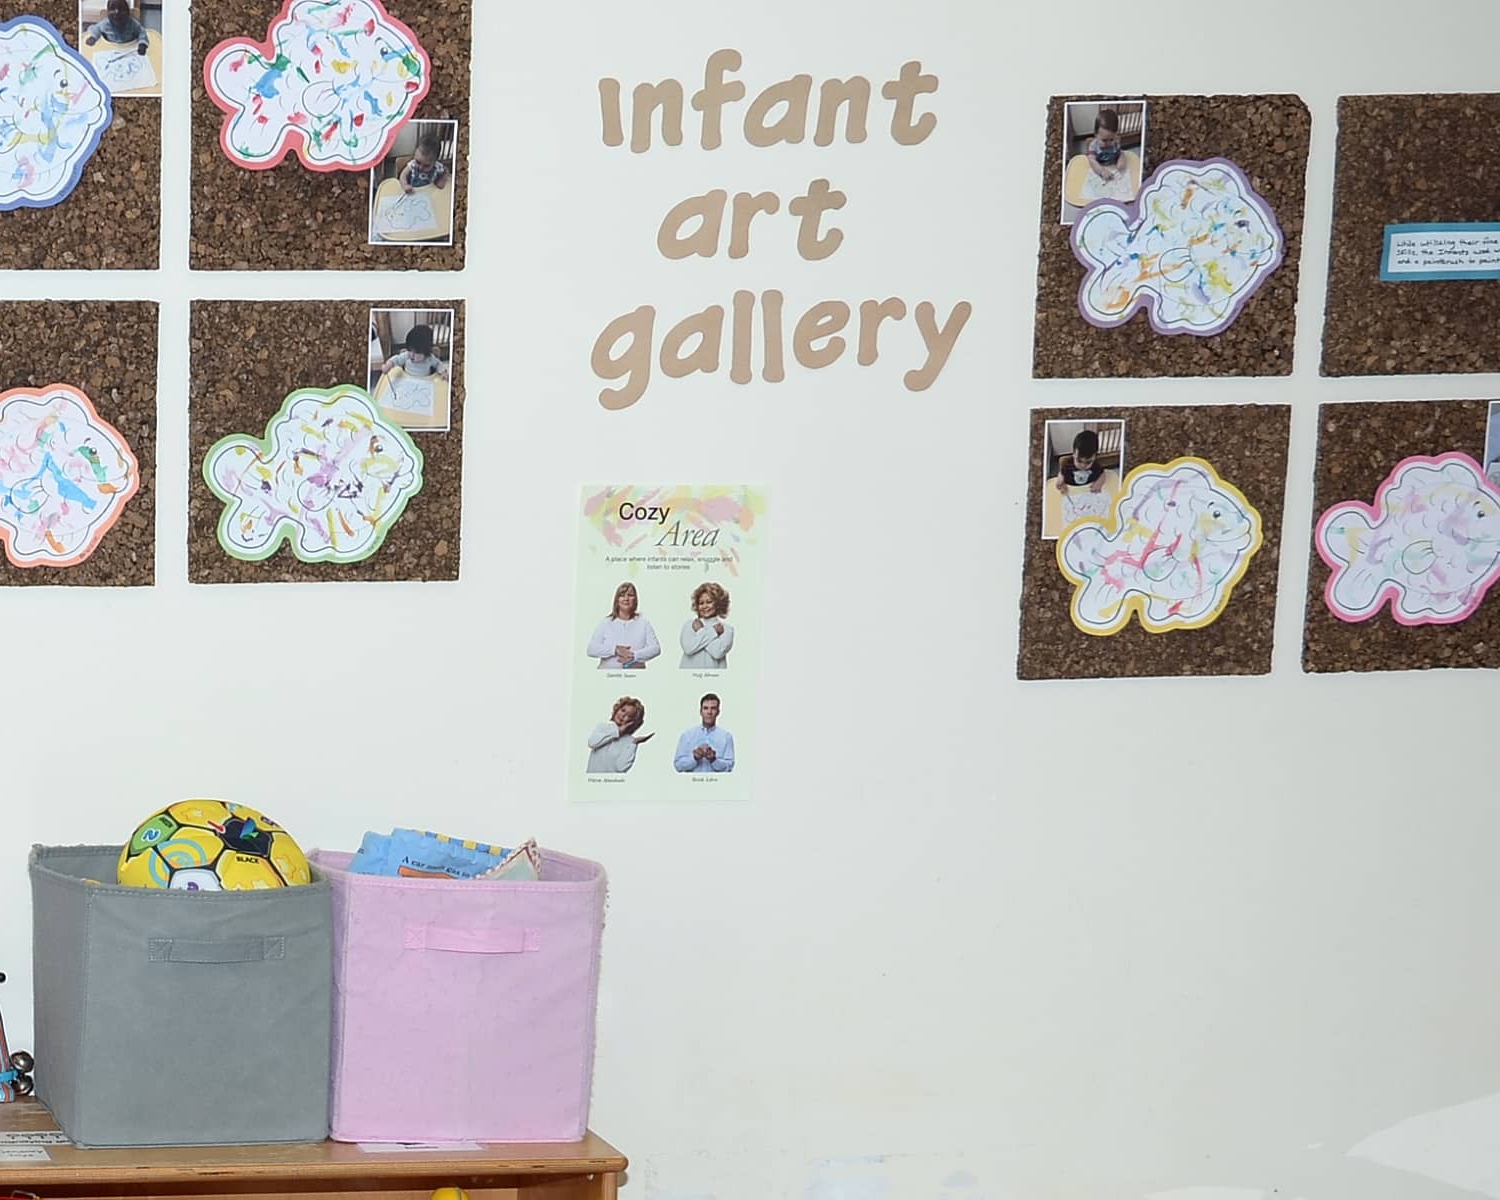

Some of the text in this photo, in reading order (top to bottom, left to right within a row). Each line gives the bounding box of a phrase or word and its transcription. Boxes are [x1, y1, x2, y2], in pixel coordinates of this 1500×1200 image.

[598, 48, 939, 154] Infant
[657, 178, 847, 261] art
[590, 289, 972, 411] gallery
[619, 502, 670, 525] Cozy
[655, 520, 720, 547] Area
[611, 556, 627, 564] place
[235, 856, 260, 864] BLACK
